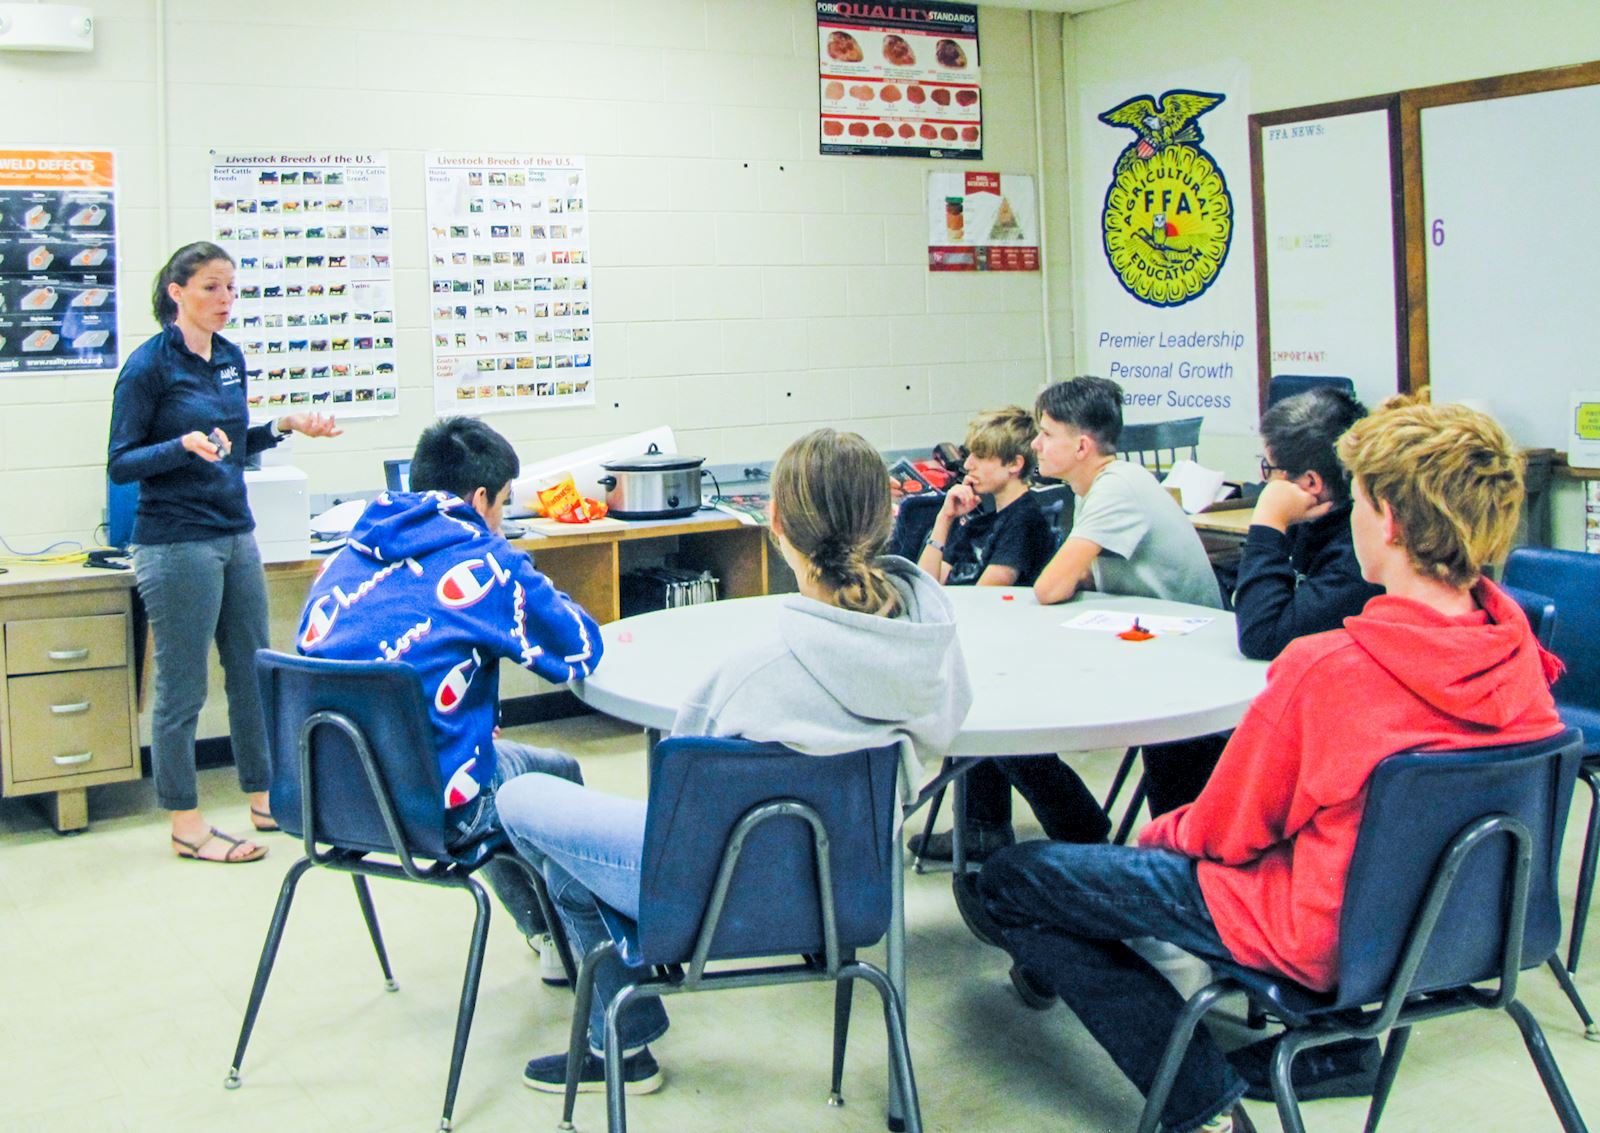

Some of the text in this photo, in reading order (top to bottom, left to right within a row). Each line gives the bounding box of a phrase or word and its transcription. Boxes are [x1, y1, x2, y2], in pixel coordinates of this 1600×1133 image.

[817, 2, 838, 13] PORK
[835, 2, 931, 22] QUALITY
[928, 10, 976, 23] STANDARDS
[1268, 125, 1325, 140] FFA NEWS:
[38, 159, 95, 171] DEFECTS
[226, 155, 375, 163] Livestock Breeds of the U.S.
[437, 156, 575, 166] Livestock Breeds of the U.S.
[1124, 167, 1210, 227] AGRICULTURAL
[1144, 190, 1192, 215] FFA
[1432, 219, 1445, 247] 6
[1130, 248, 1204, 281] EDUCATION
[1099, 330, 1244, 351] Premier Leadership
[1110, 361, 1233, 379] Personal Growth
[1121, 390, 1232, 409] areer Success
